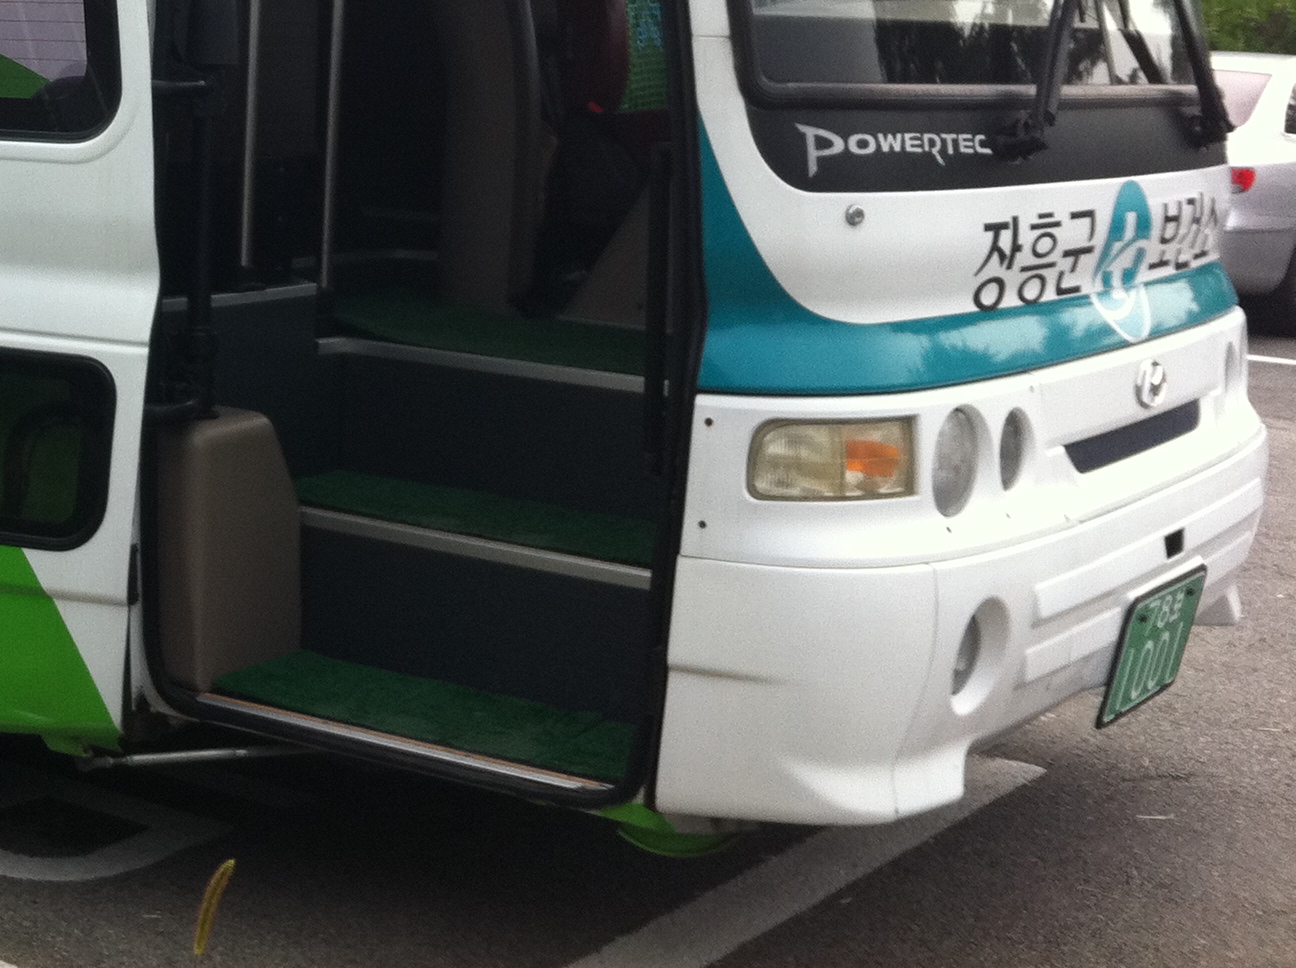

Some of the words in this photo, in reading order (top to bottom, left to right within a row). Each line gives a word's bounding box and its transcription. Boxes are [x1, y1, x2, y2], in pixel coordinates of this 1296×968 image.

[973, 209, 1096, 312] 장흥군
[1148, 191, 1219, 271] 보건소
[1115, 621, 1184, 712] 1001
